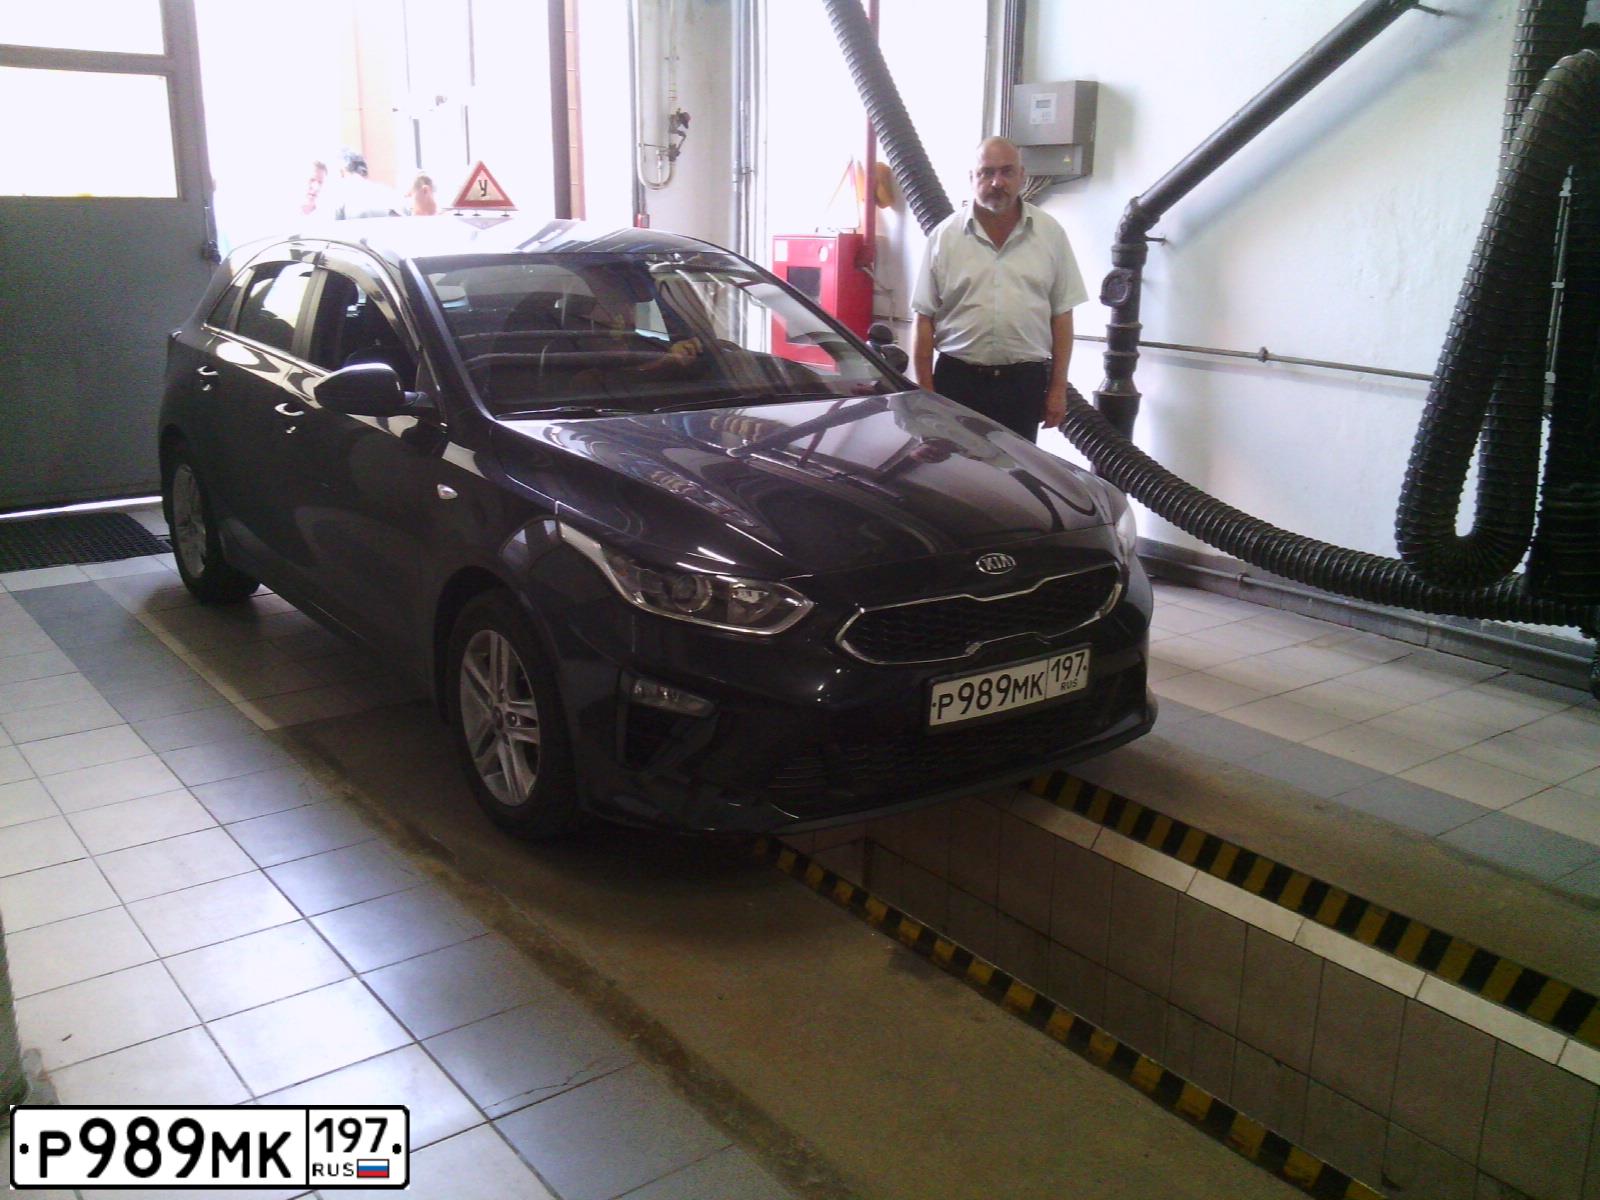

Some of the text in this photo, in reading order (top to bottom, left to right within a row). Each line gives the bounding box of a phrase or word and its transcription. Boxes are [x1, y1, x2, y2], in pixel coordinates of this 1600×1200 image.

[981, 555, 1013, 571] KIA
[1050, 652, 1086, 682] 197
[1060, 679, 1078, 692] RUS
